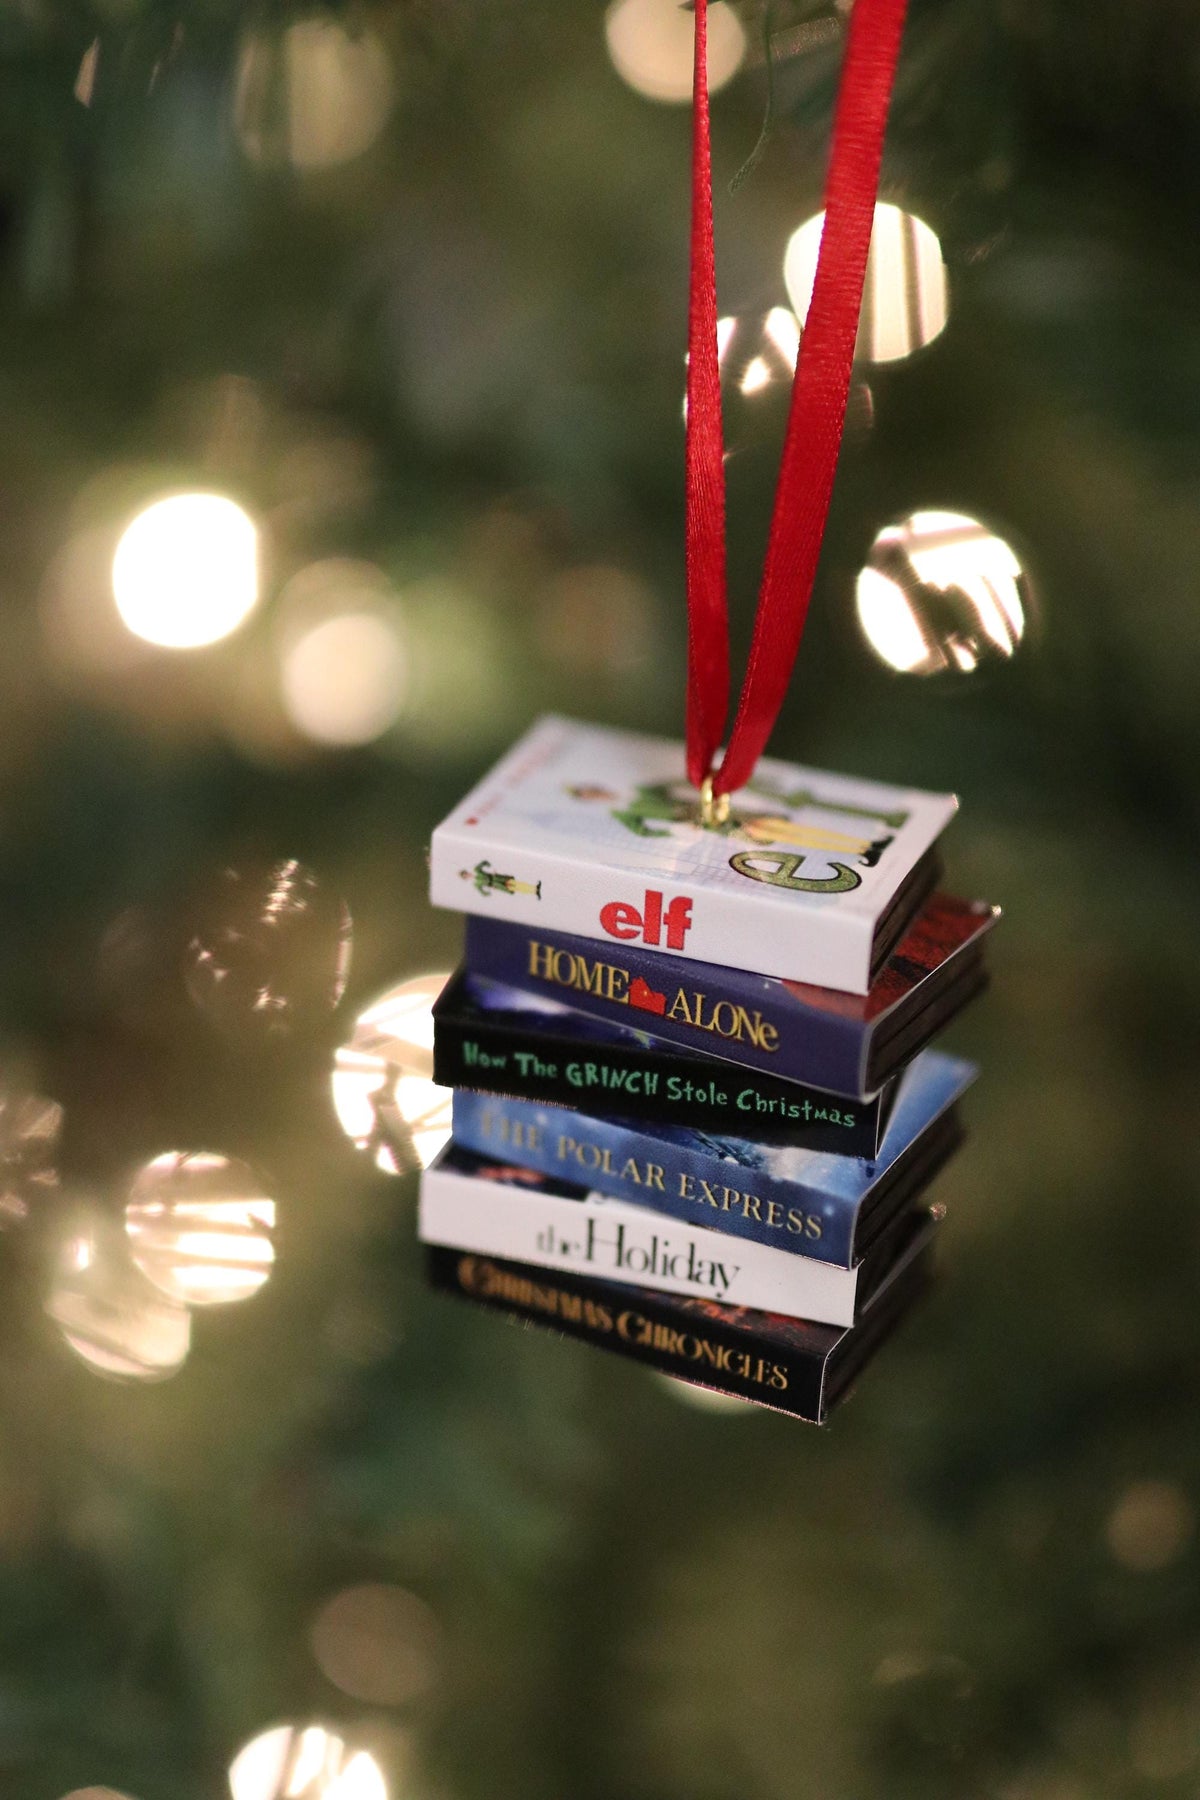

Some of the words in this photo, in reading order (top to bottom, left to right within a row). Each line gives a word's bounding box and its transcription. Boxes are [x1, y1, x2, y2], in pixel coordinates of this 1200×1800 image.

[600, 889, 693, 950] elf
[527, 940, 630, 1004] HOME
[463, 1041, 507, 1067] How
[514, 1053, 558, 1077] The
[566, 1063, 659, 1095] GRINCH
[667, 1076, 728, 1106] Stole
[736, 1089, 856, 1128] Christmas
[476, 1108, 544, 1150] THE
[557, 1135, 665, 1190] POLAR
[677, 1172, 823, 1240] EXPRESS
[585, 1217, 741, 1299] Holiday
[616, 1310, 789, 1391] CHRONICLES
